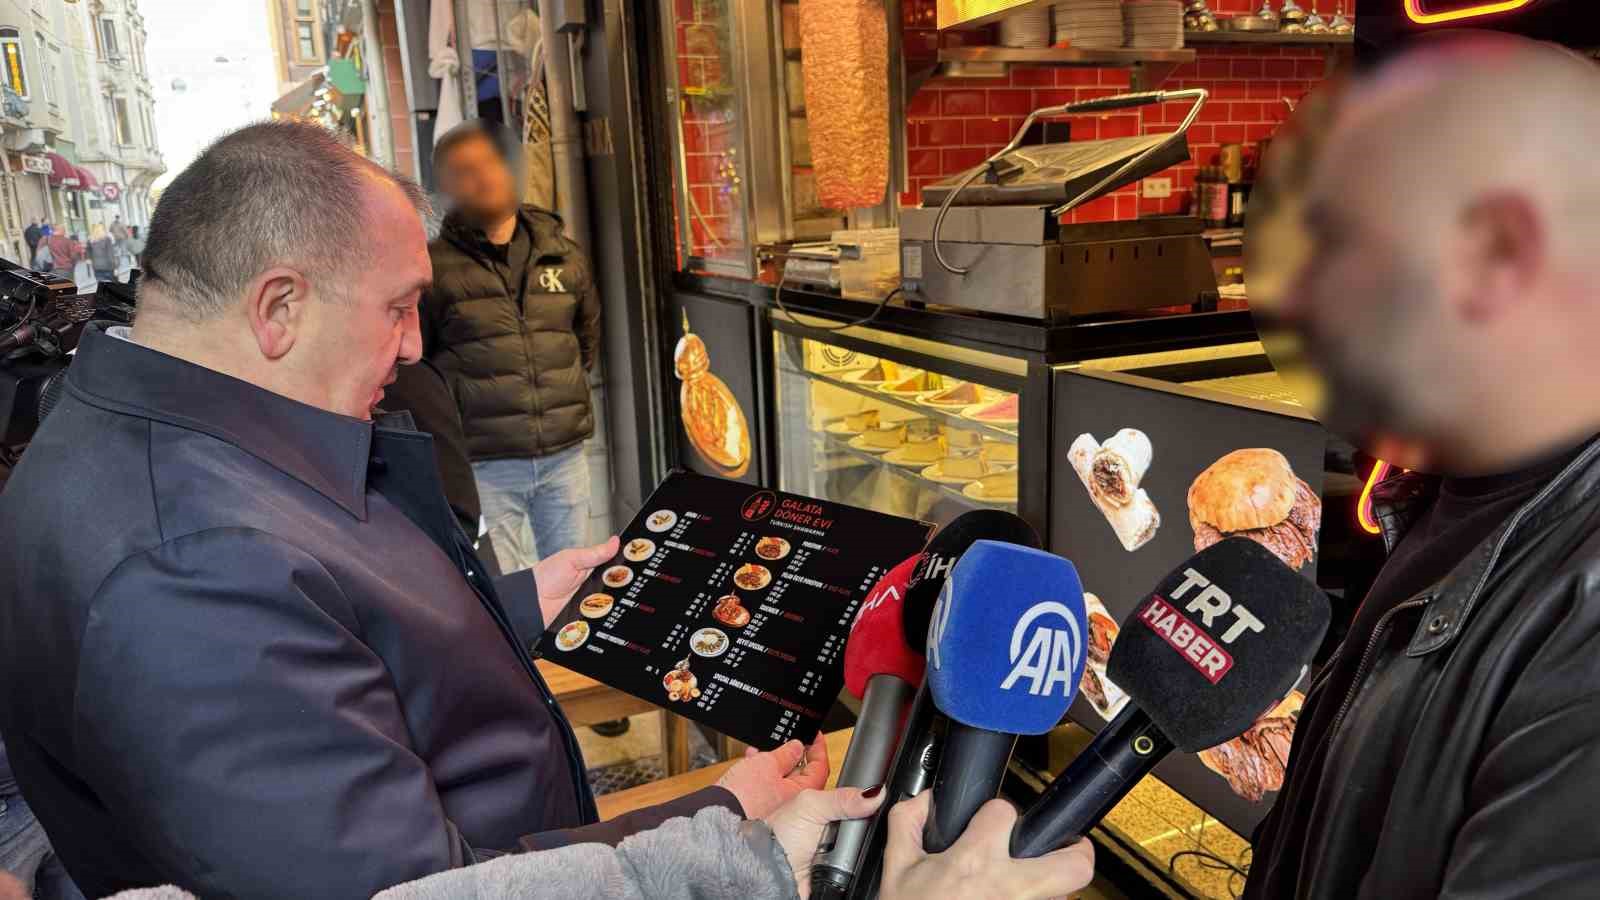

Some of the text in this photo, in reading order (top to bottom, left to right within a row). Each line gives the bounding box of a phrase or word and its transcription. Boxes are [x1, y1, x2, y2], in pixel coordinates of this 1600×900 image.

[781, 499, 823, 514] GALATA
[924, 552, 956, 579] İH
[1142, 601, 1226, 677] HABER
[1169, 567, 1265, 644] TRT
[1000, 626, 1072, 697] AA
